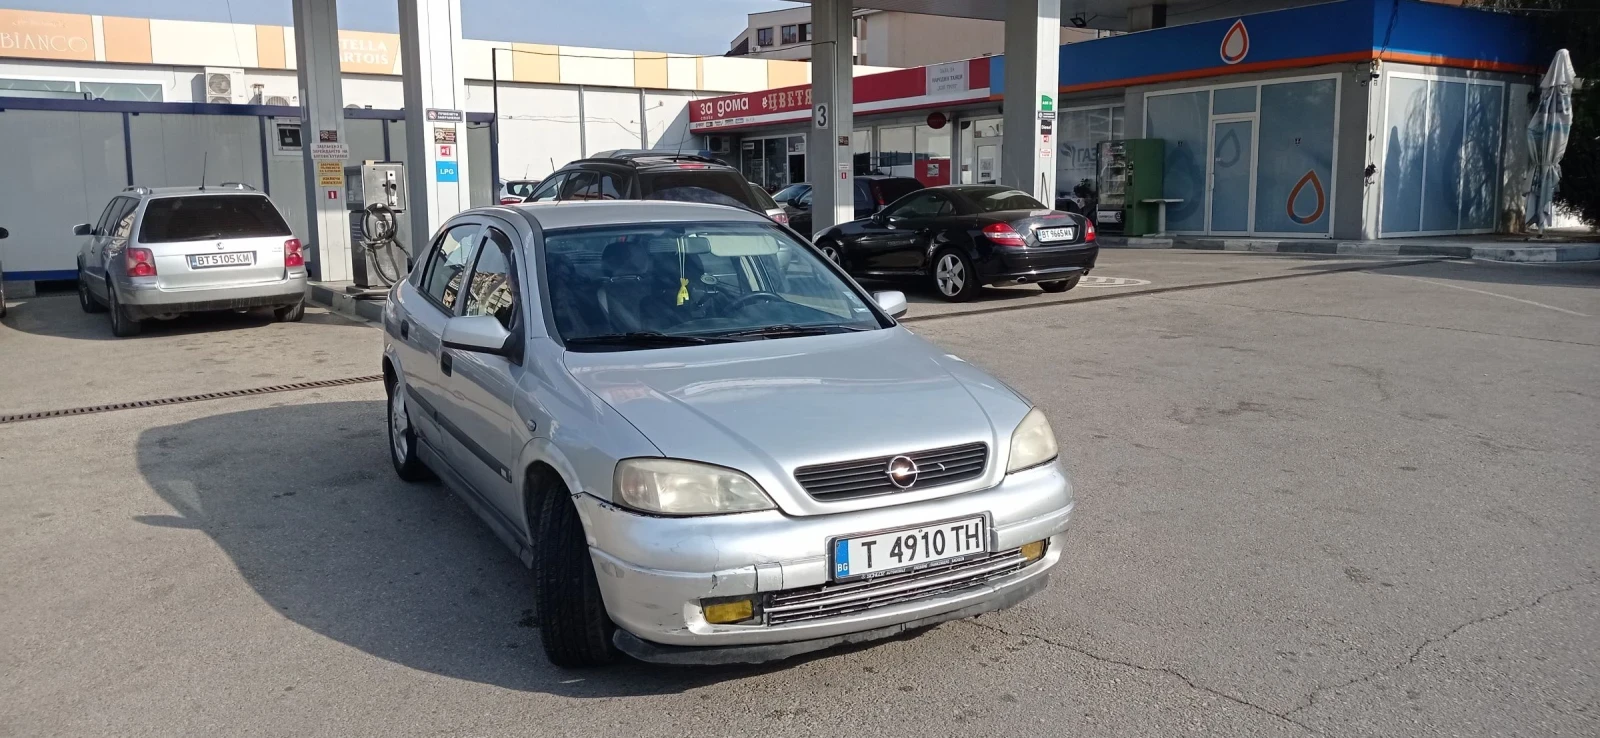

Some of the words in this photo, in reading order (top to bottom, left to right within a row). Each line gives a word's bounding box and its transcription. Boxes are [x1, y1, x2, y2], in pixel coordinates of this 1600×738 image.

[0, 32, 88, 52] BIANCO
[340, 39, 389, 52] TELLA
[767, 88, 812, 111] ЦВЕТЯ
[817, 105, 827, 127] 3
[197, 256, 210, 265] BT
[212, 254, 236, 264] 5105
[237, 253, 250, 262] KM
[861, 540, 877, 569] T
[889, 529, 946, 564] 4910
[950, 522, 980, 553] TH
[837, 563, 848, 572] BG
